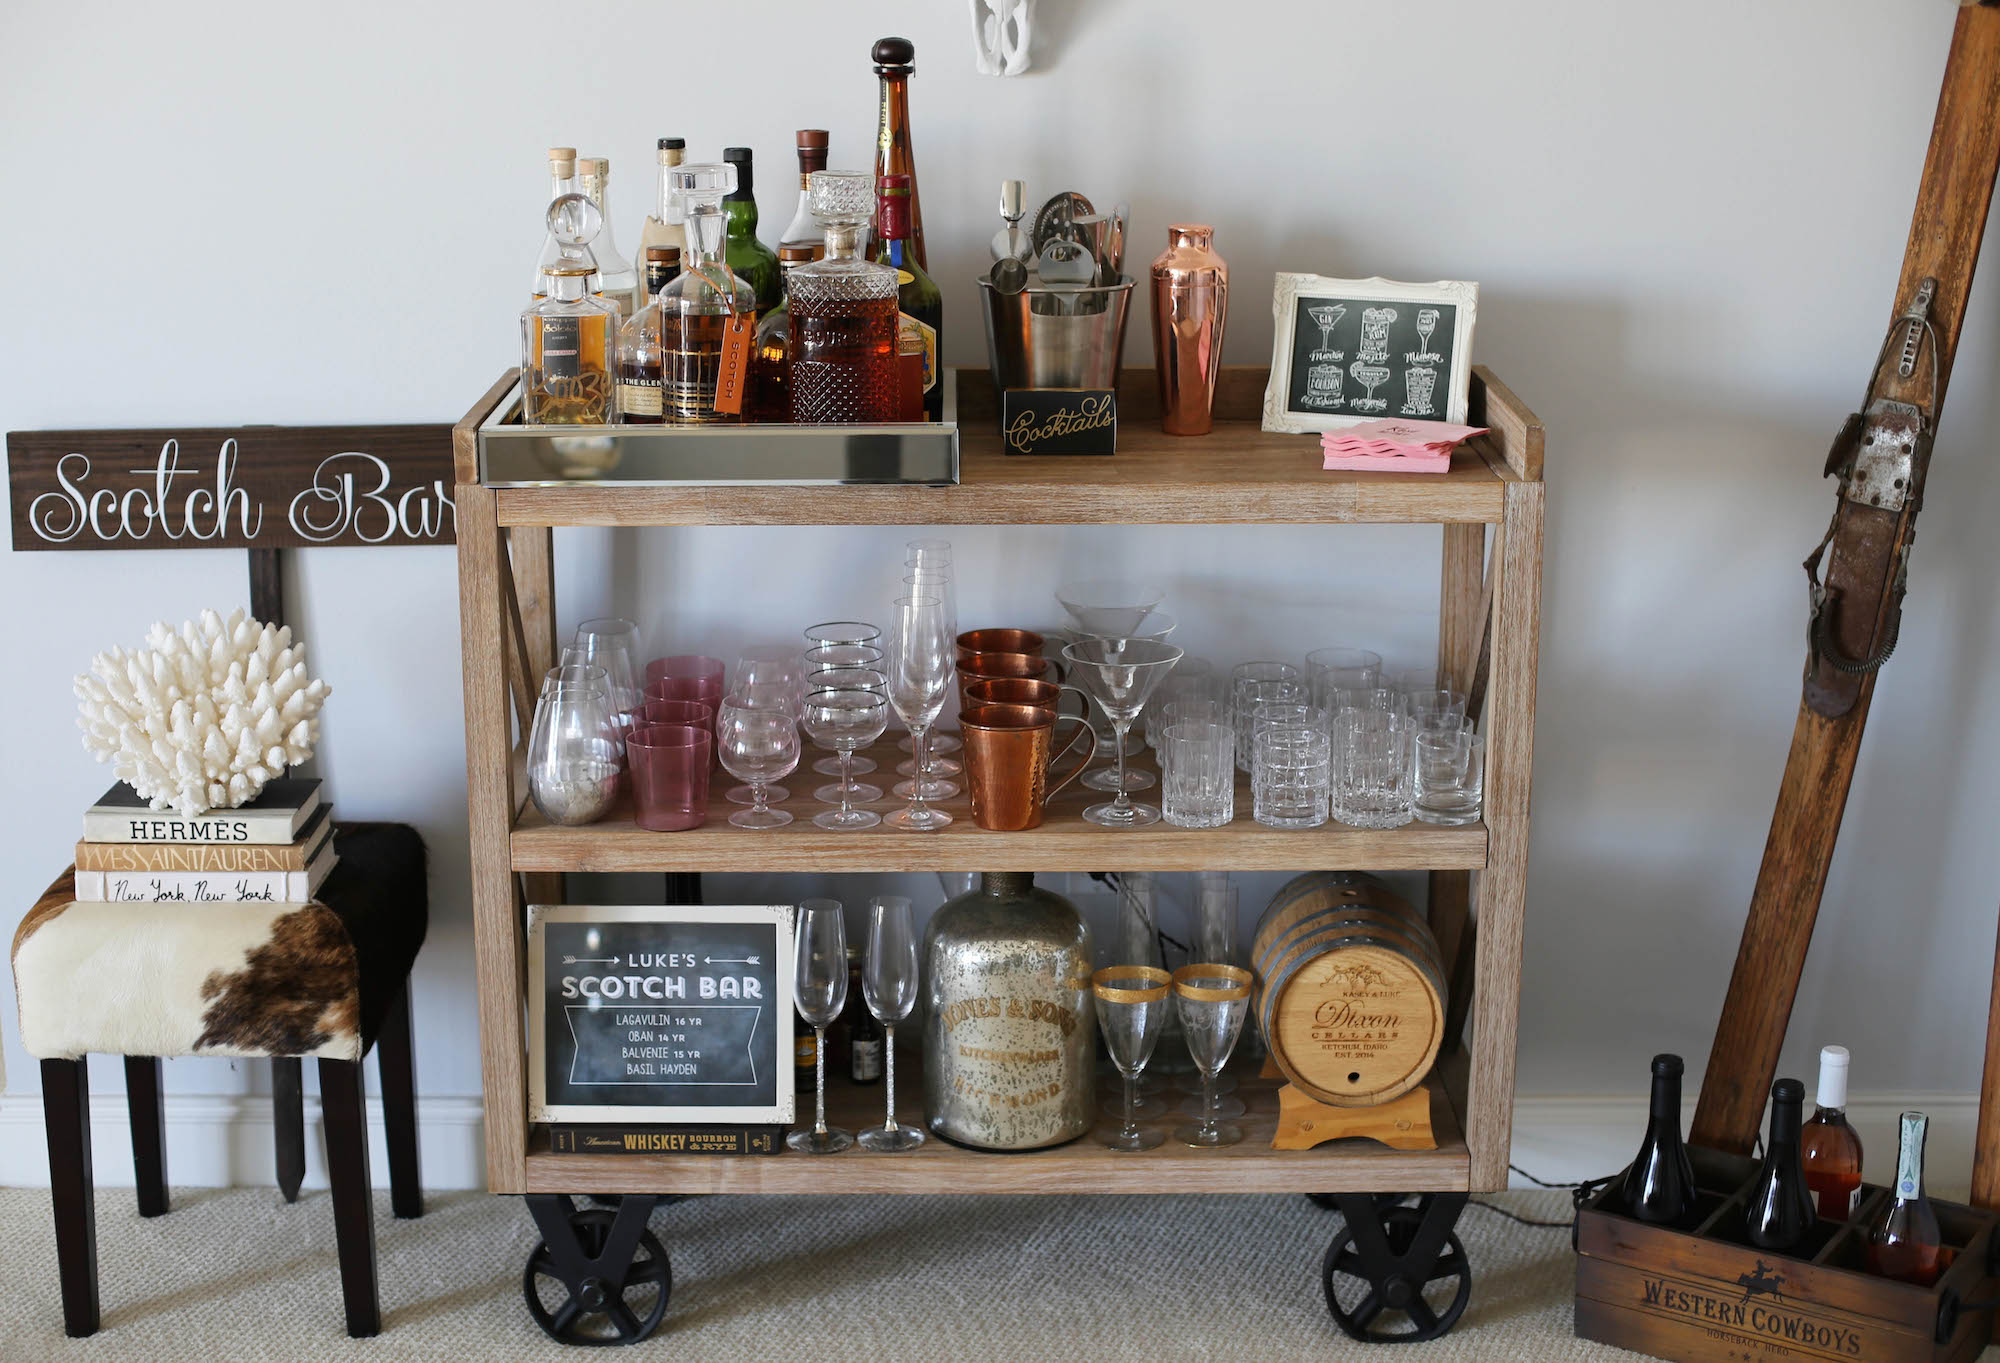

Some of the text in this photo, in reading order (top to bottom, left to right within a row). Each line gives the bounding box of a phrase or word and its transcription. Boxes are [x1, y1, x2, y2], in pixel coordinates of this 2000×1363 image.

[1319, 314, 1332, 324] GIN
[1369, 328, 1387, 341] RUM
[1355, 352, 1390, 364] Mojito
[1403, 352, 1443, 364] Mimosa
[725, 341, 741, 399] SCOTCH
[625, 378, 639, 386] THE
[1005, 394, 1115, 453] Cocktails
[29, 437, 458, 543] Scotch Bar
[115, 880, 144, 902] New
[194, 880, 226, 902] New
[235, 879, 275, 902] York
[628, 953, 696, 968] LUKE'S
[561, 975, 763, 999] SCOTCH BAR
[616, 1014, 702, 1026] LAGAVULIN 16 YR
[941, 996, 1002, 1033] JONES
[1007, 1000, 1024, 1018] &
[1312, 999, 1402, 1030] Dixon
[628, 1031, 685, 1042] OBAN 14 YR
[622, 1047, 700, 1058] BALVENIE 15 YR
[627, 1063, 697, 1075] BASIL HAYDEN
[624, 1135, 686, 1150] WHISKEY
[1642, 1279, 1863, 1354] WESTERN COWBOYS
[1706, 1327, 1789, 1356] HORSEBACK HERO
